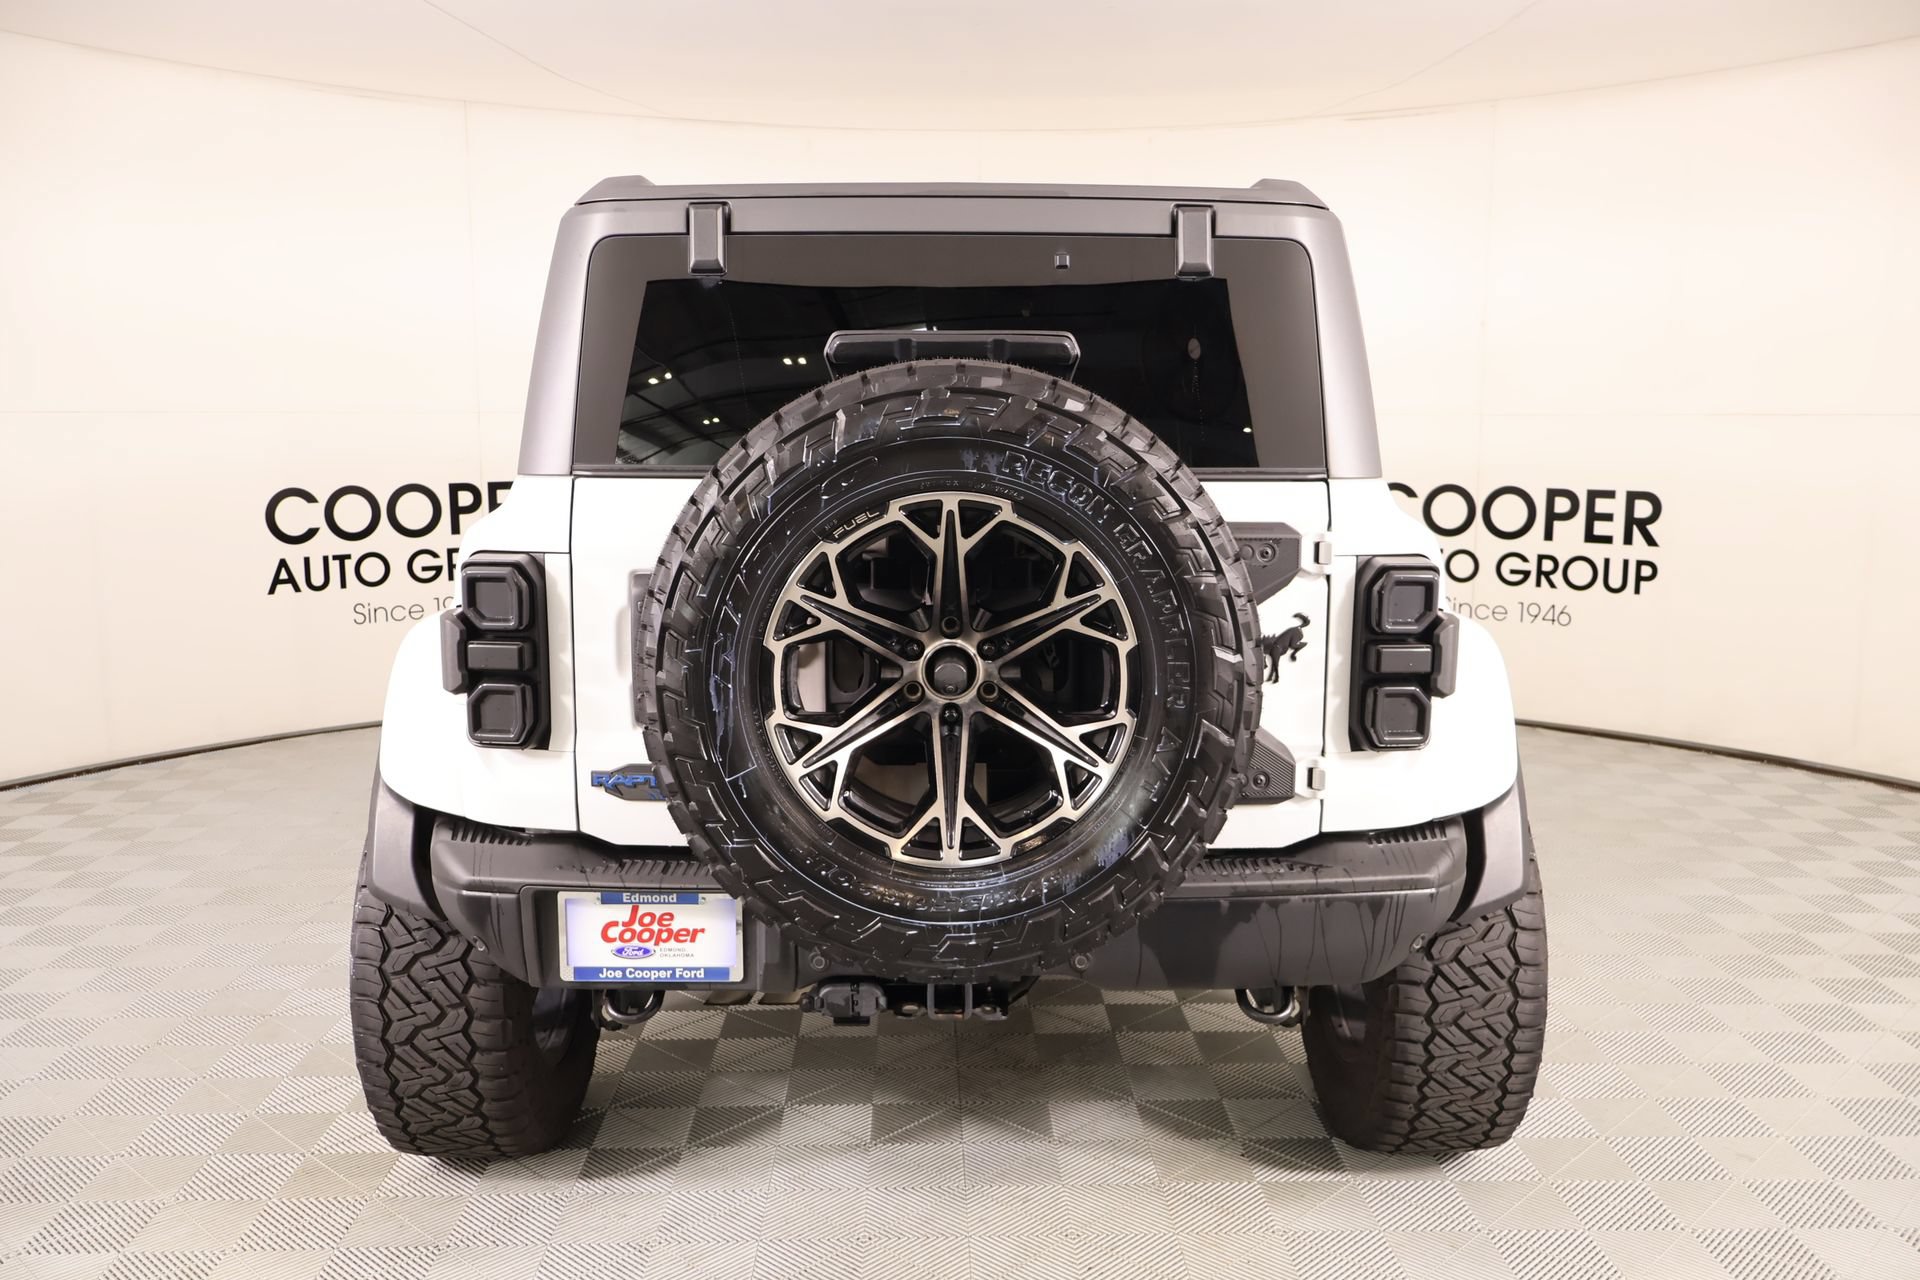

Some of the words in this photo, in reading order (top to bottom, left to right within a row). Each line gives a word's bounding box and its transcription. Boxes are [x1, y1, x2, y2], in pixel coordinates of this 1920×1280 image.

[832, 511, 880, 539] FUEL
[267, 552, 391, 595] AUTO
[1495, 552, 1658, 595] GROUP
[353, 603, 425, 625] Since
[1446, 596, 1508, 622] ince
[1517, 601, 1572, 627] 1946
[622, 892, 677, 903] Edmond
[621, 904, 675, 928] Joe
[600, 920, 705, 946] Cooper
[599, 968, 623, 979] Joe
[625, 968, 672, 981] Cooper
[675, 968, 705, 979] Ford
